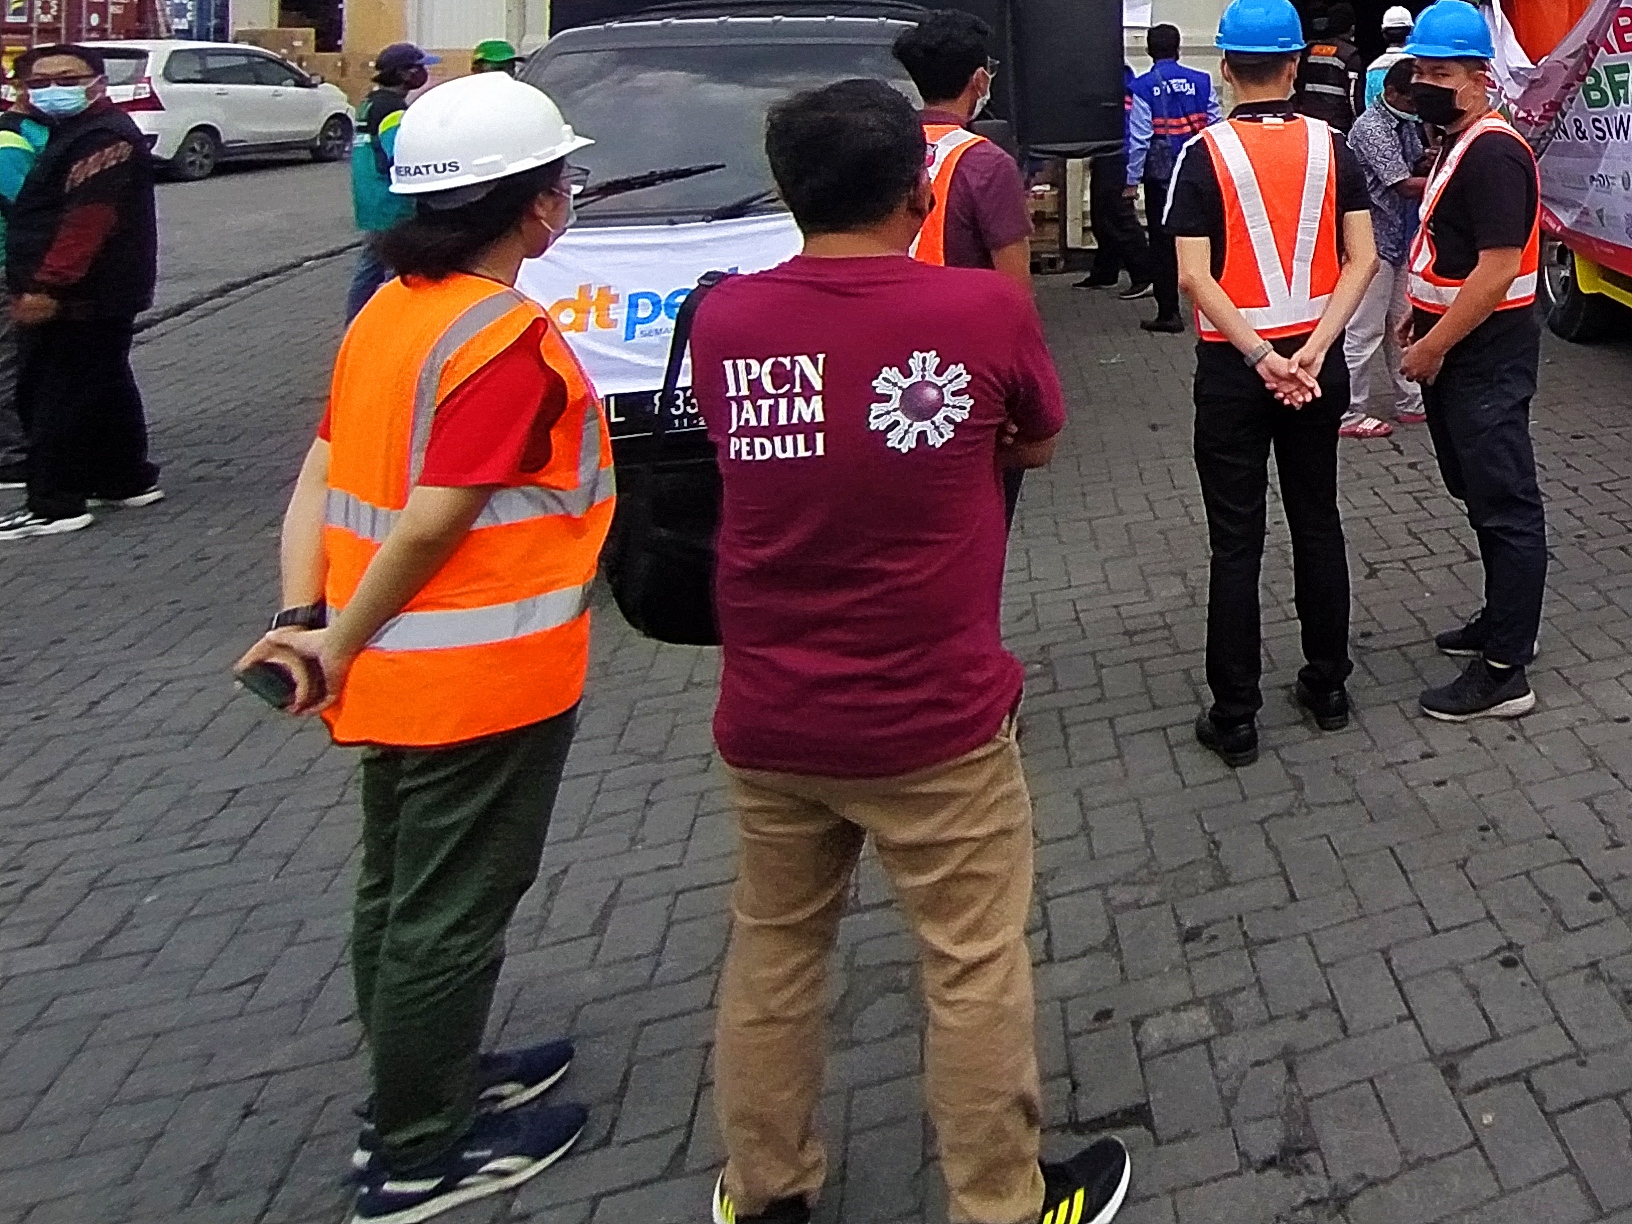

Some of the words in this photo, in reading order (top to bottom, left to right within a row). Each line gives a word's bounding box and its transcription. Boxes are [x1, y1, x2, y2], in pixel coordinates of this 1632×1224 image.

[394, 161, 461, 178] ERATUS
[722, 353, 826, 398] IPCN
[609, 396, 626, 423] L
[728, 394, 826, 434] JATIM
[729, 432, 826, 461] PEDULI
